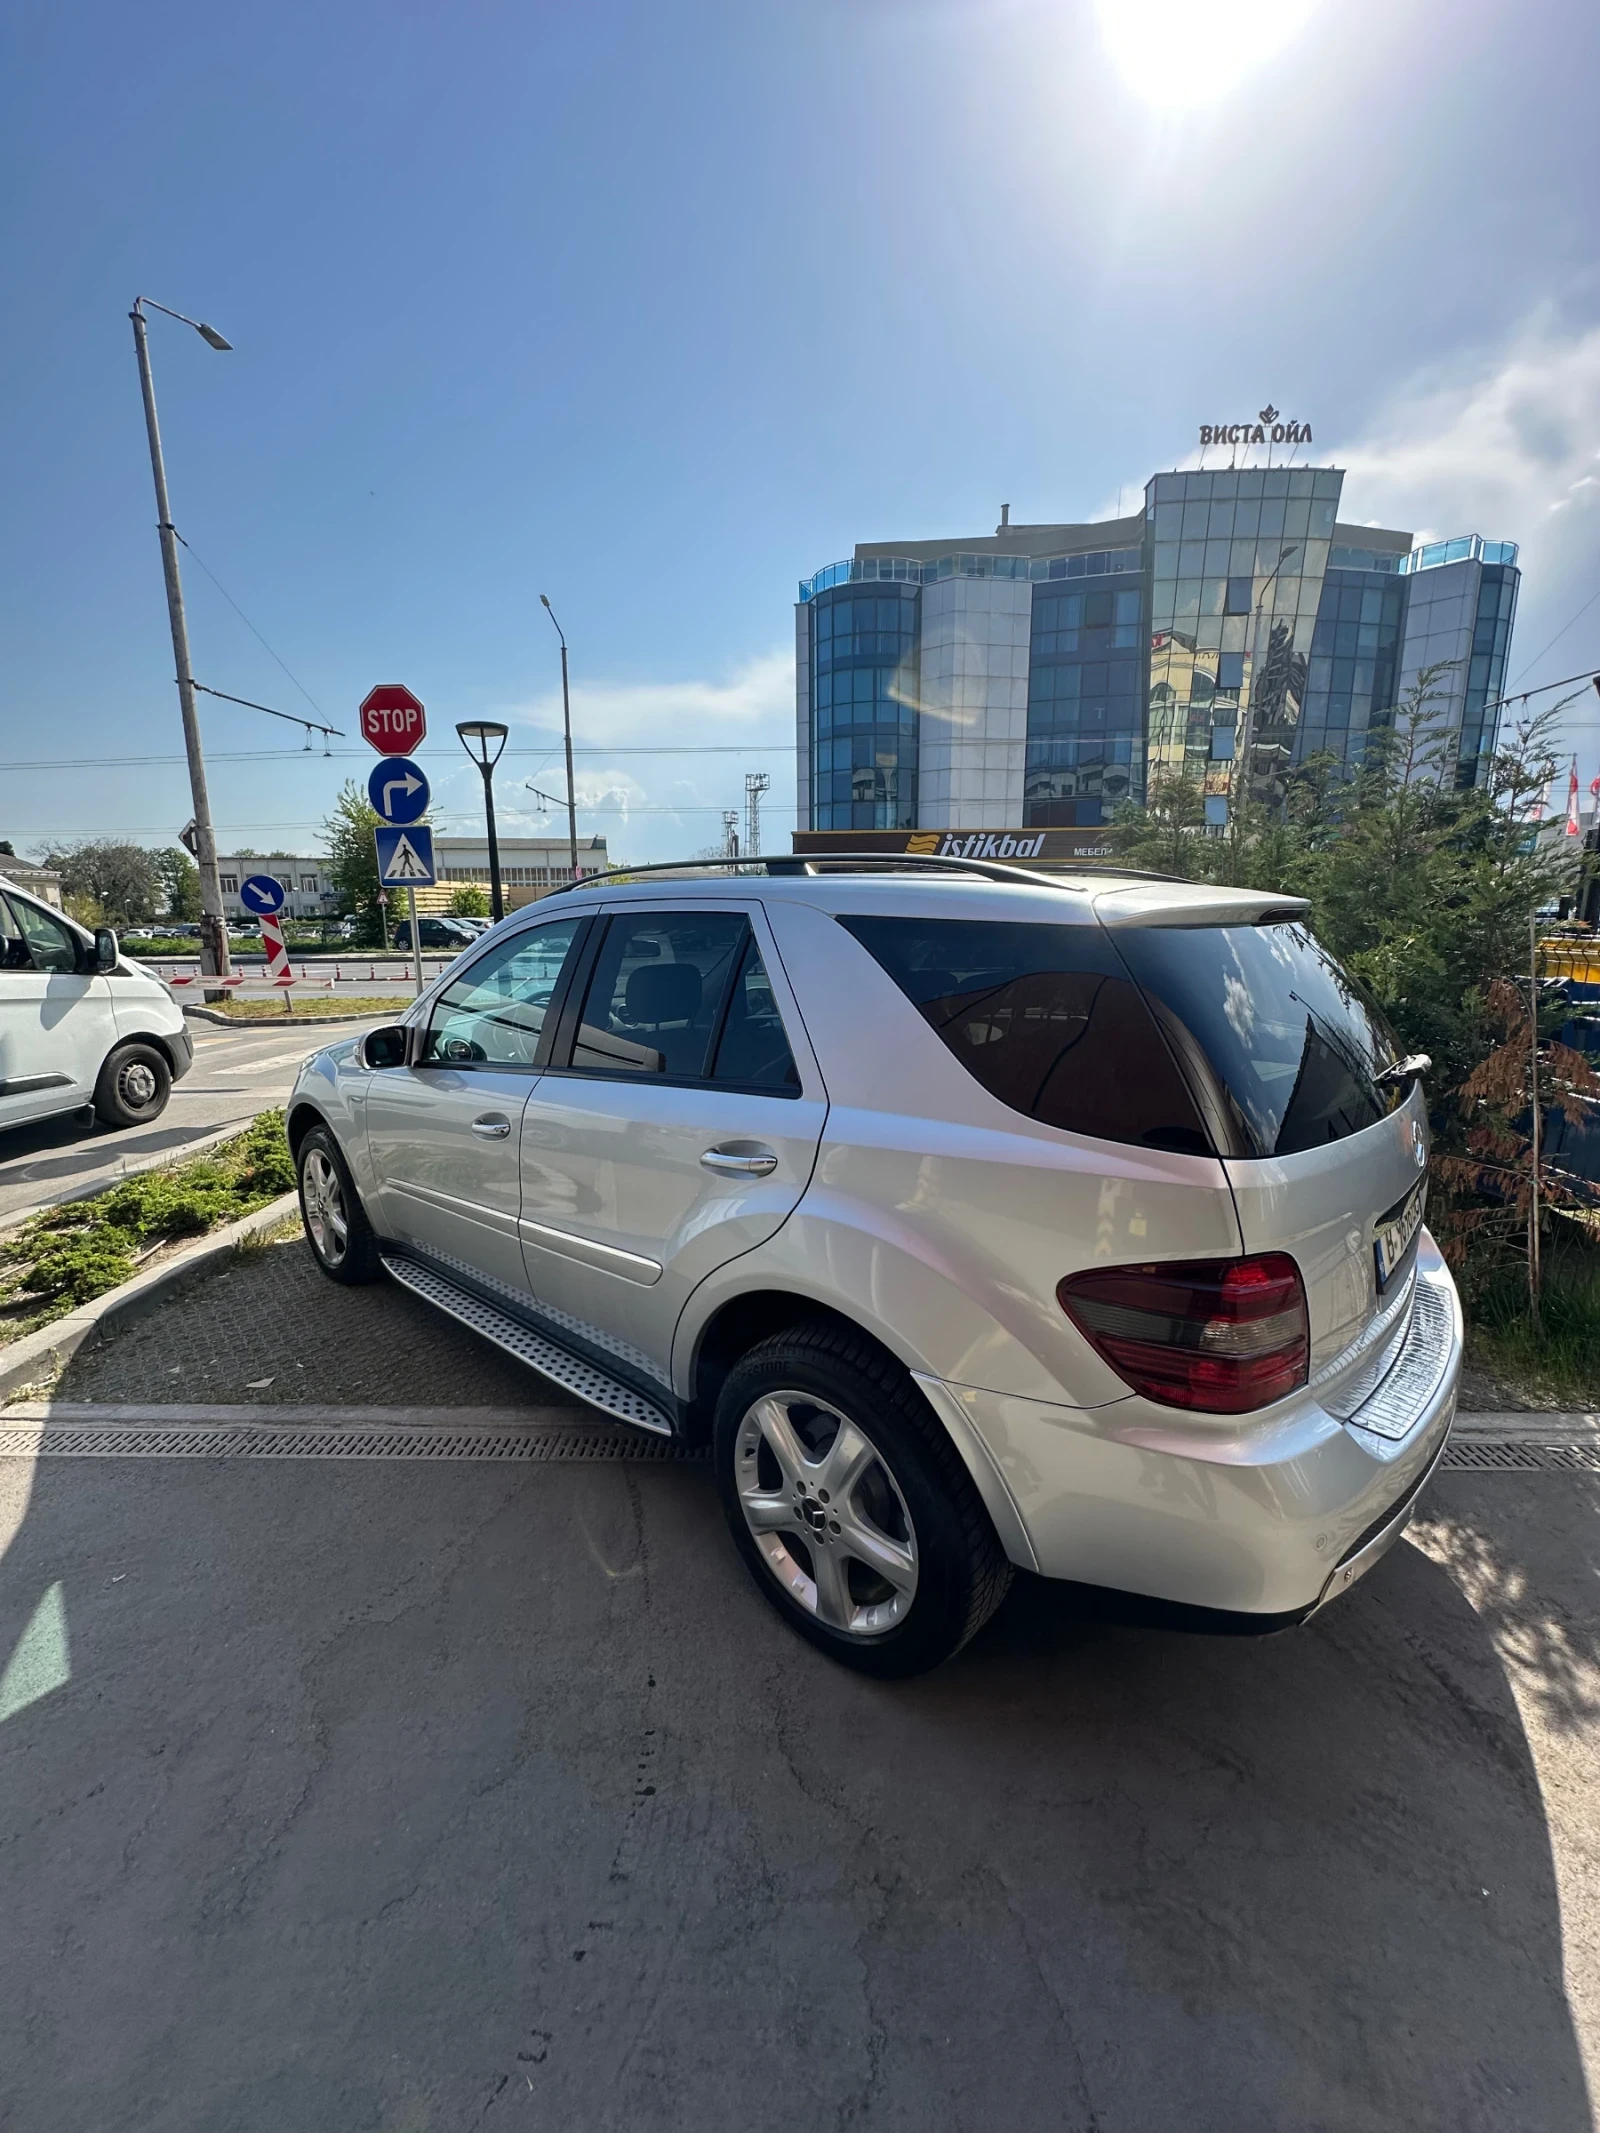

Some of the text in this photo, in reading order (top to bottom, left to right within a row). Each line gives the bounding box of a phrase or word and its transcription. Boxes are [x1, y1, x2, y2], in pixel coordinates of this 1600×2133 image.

[1199, 420, 1312, 445] ВИСТА ОЙЛ
[367, 708, 418, 733] STOP
[940, 833, 1046, 858] istikbal
